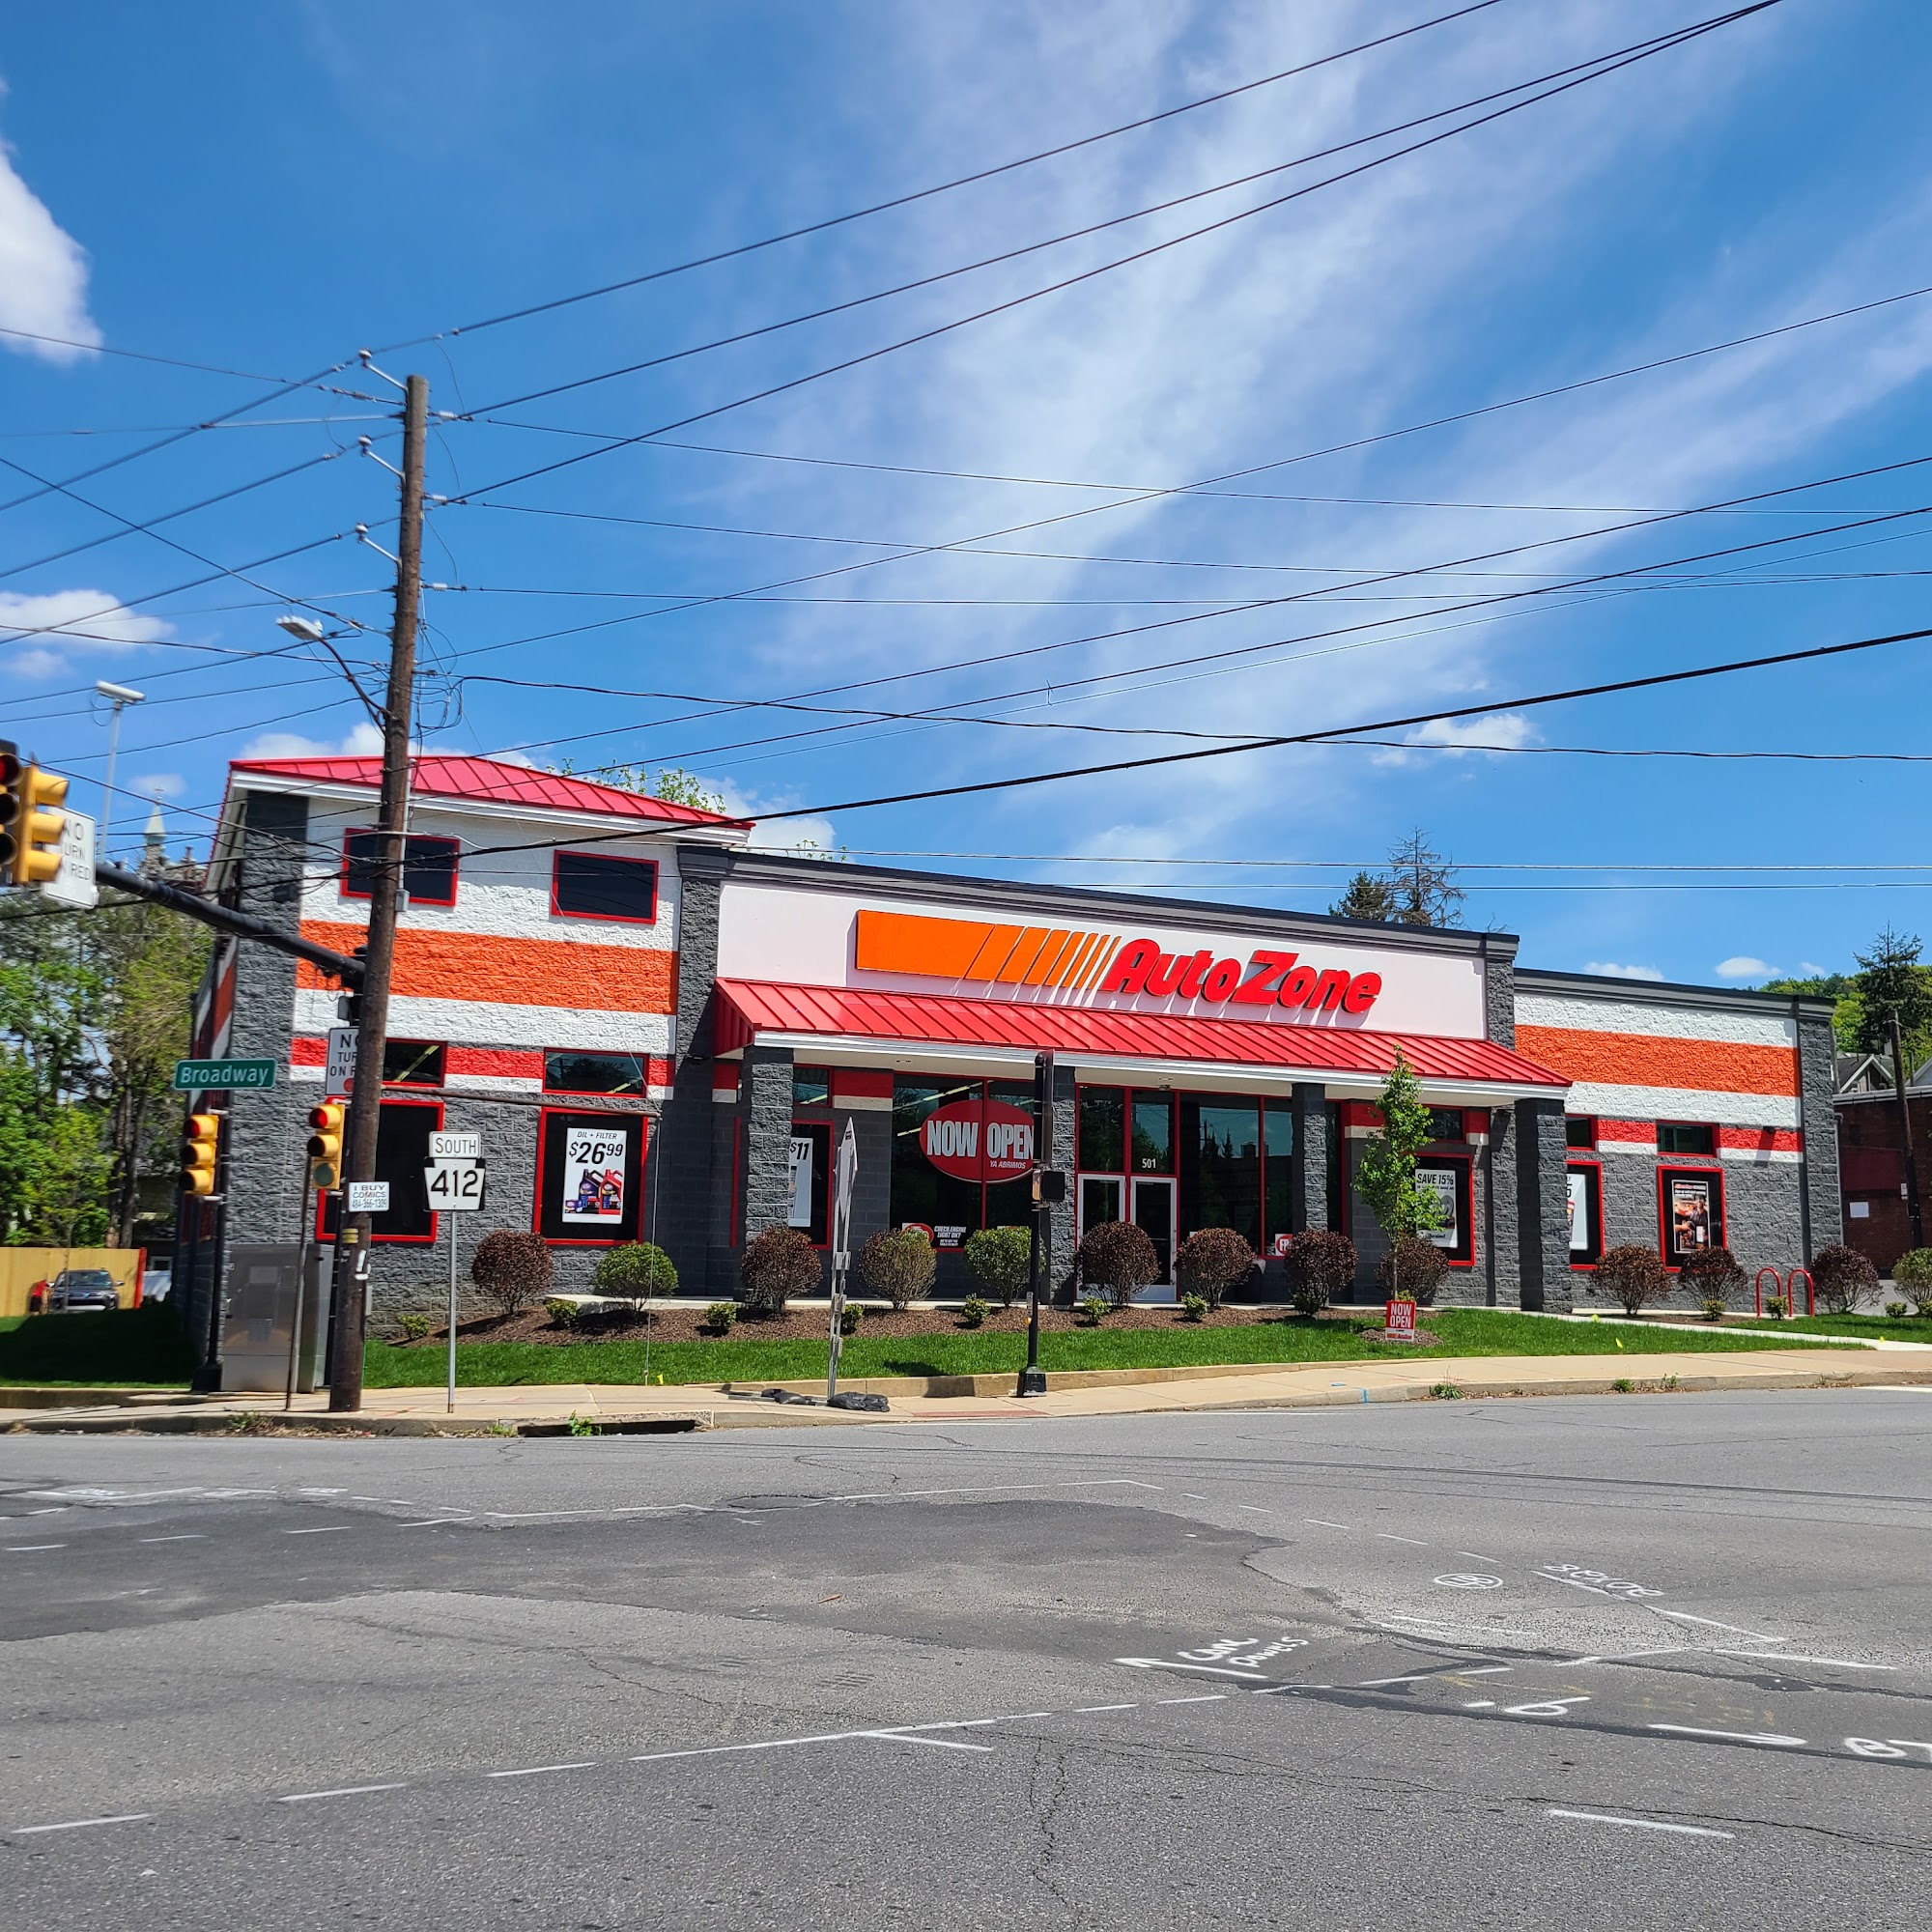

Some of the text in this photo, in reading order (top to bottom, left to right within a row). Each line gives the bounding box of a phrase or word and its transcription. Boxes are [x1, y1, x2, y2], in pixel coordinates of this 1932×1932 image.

[64, 818, 84, 840] NO
[63, 843, 86, 861] URN
[71, 863, 92, 880] RED
[1098, 939, 1382, 1014] AutoZone
[181, 1065, 269, 1086] Broadway
[330, 1065, 347, 1076] ON
[435, 1137, 477, 1154] SOUTH
[927, 1120, 1034, 1160] NOW OPEN
[998, 1161, 1026, 1170] ABRIMOS
[1142, 1158, 1156, 1169] 501
[431, 1169, 479, 1197] 412
[1416, 1173, 1454, 1185] SAVE 15%
[1391, 1303, 1412, 1316] NOW
[1389, 1315, 1411, 1328] OPEN
